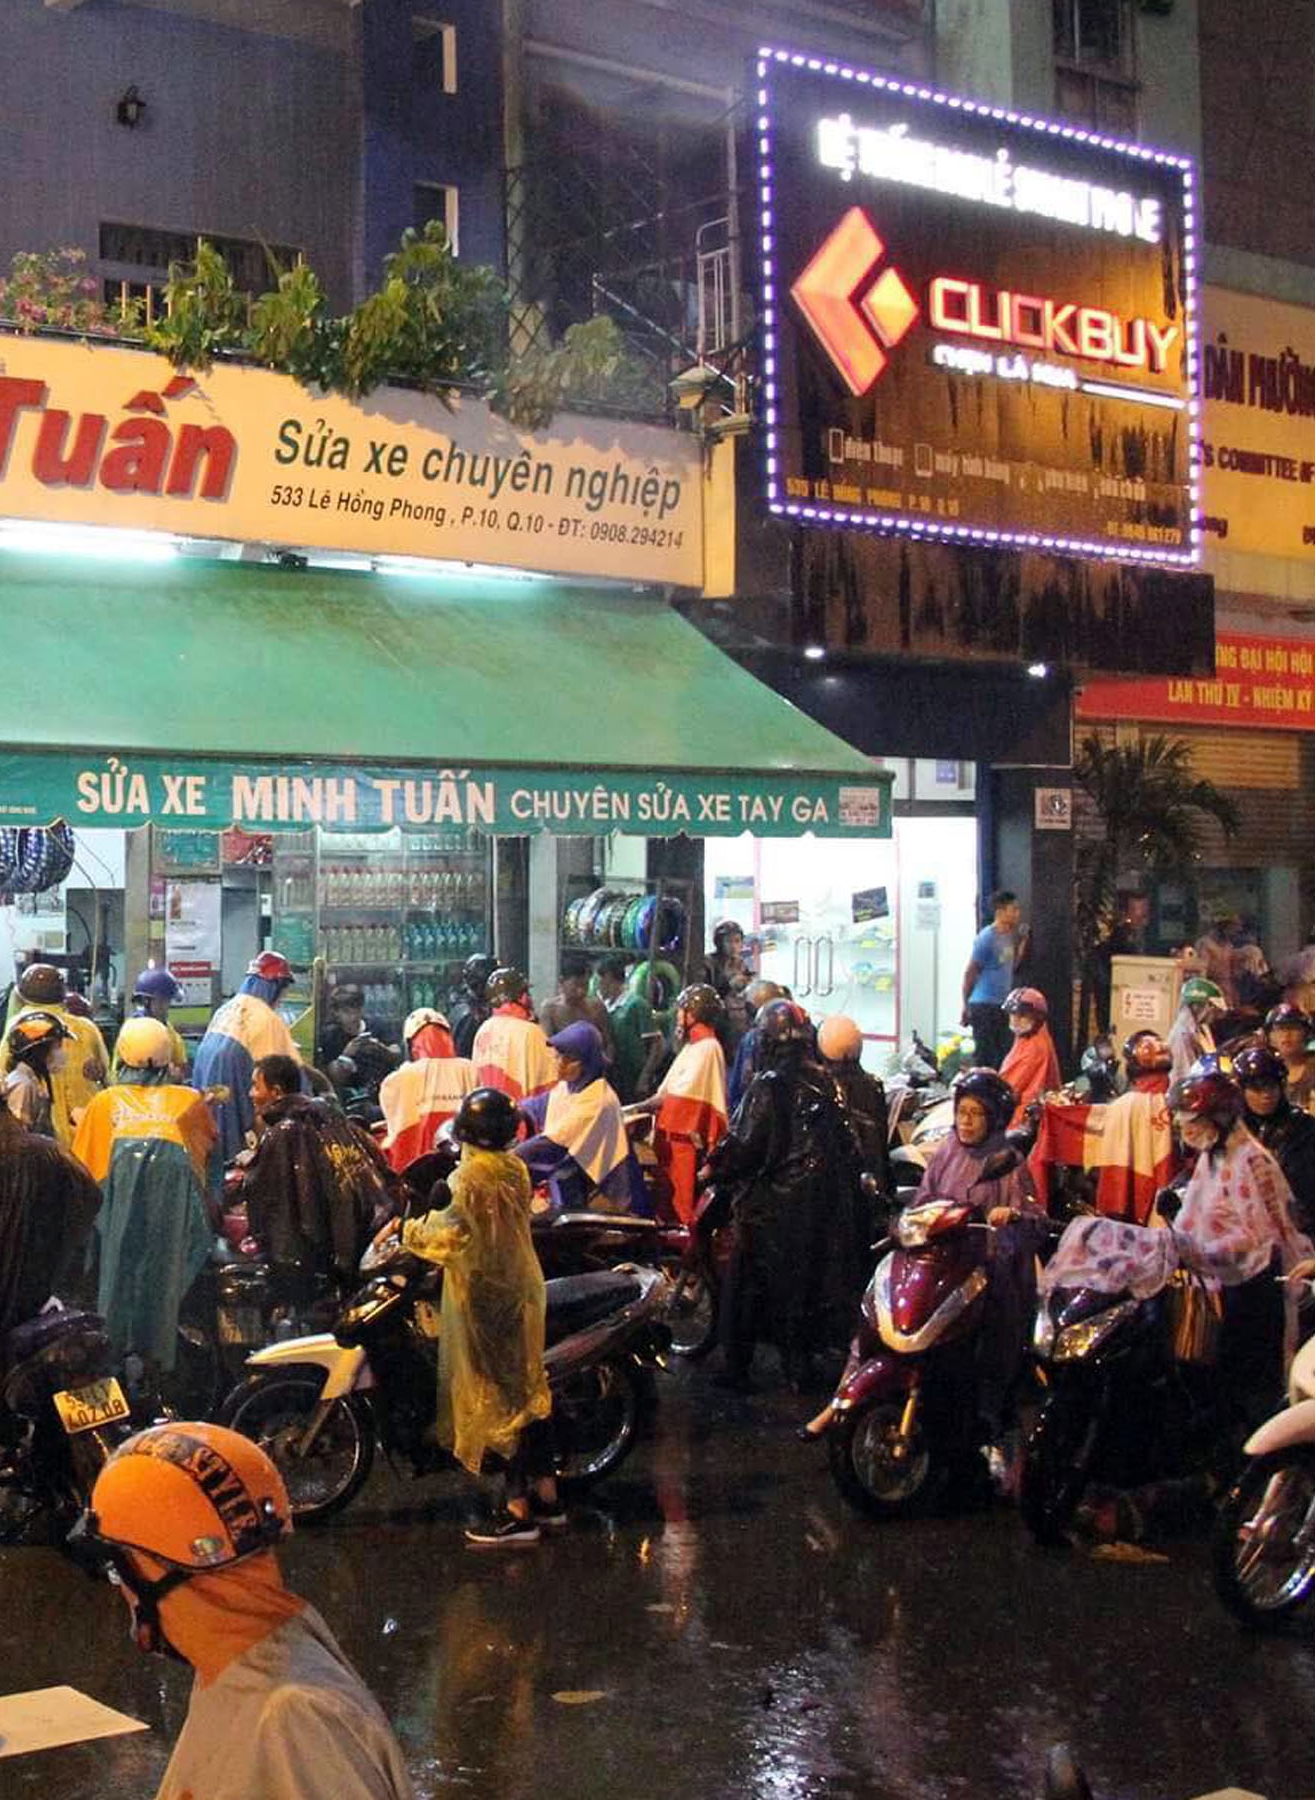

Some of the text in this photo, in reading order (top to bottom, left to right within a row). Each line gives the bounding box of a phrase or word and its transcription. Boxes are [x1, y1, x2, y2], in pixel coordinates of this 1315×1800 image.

[930, 277, 1178, 373] CLICKBUY
[270, 485, 304, 509] 533
[308, 487, 331, 511] Lê
[337, 487, 385, 521] Hồng
[507, 511, 544, 535] Q.10
[274, 417, 681, 522] Sửa xe chuyên nghiệp
[77, 757, 150, 814] SỬA
[162, 775, 207, 815] XE
[232, 775, 358, 824] MINH
[373, 769, 495, 824] TUẤN
[510, 783, 630, 821] CHUYÊN
[637, 781, 691, 821] SỬA
[697, 794, 731, 822] XE
[738, 795, 783, 822] TAY
[791, 796, 829, 823] GA
